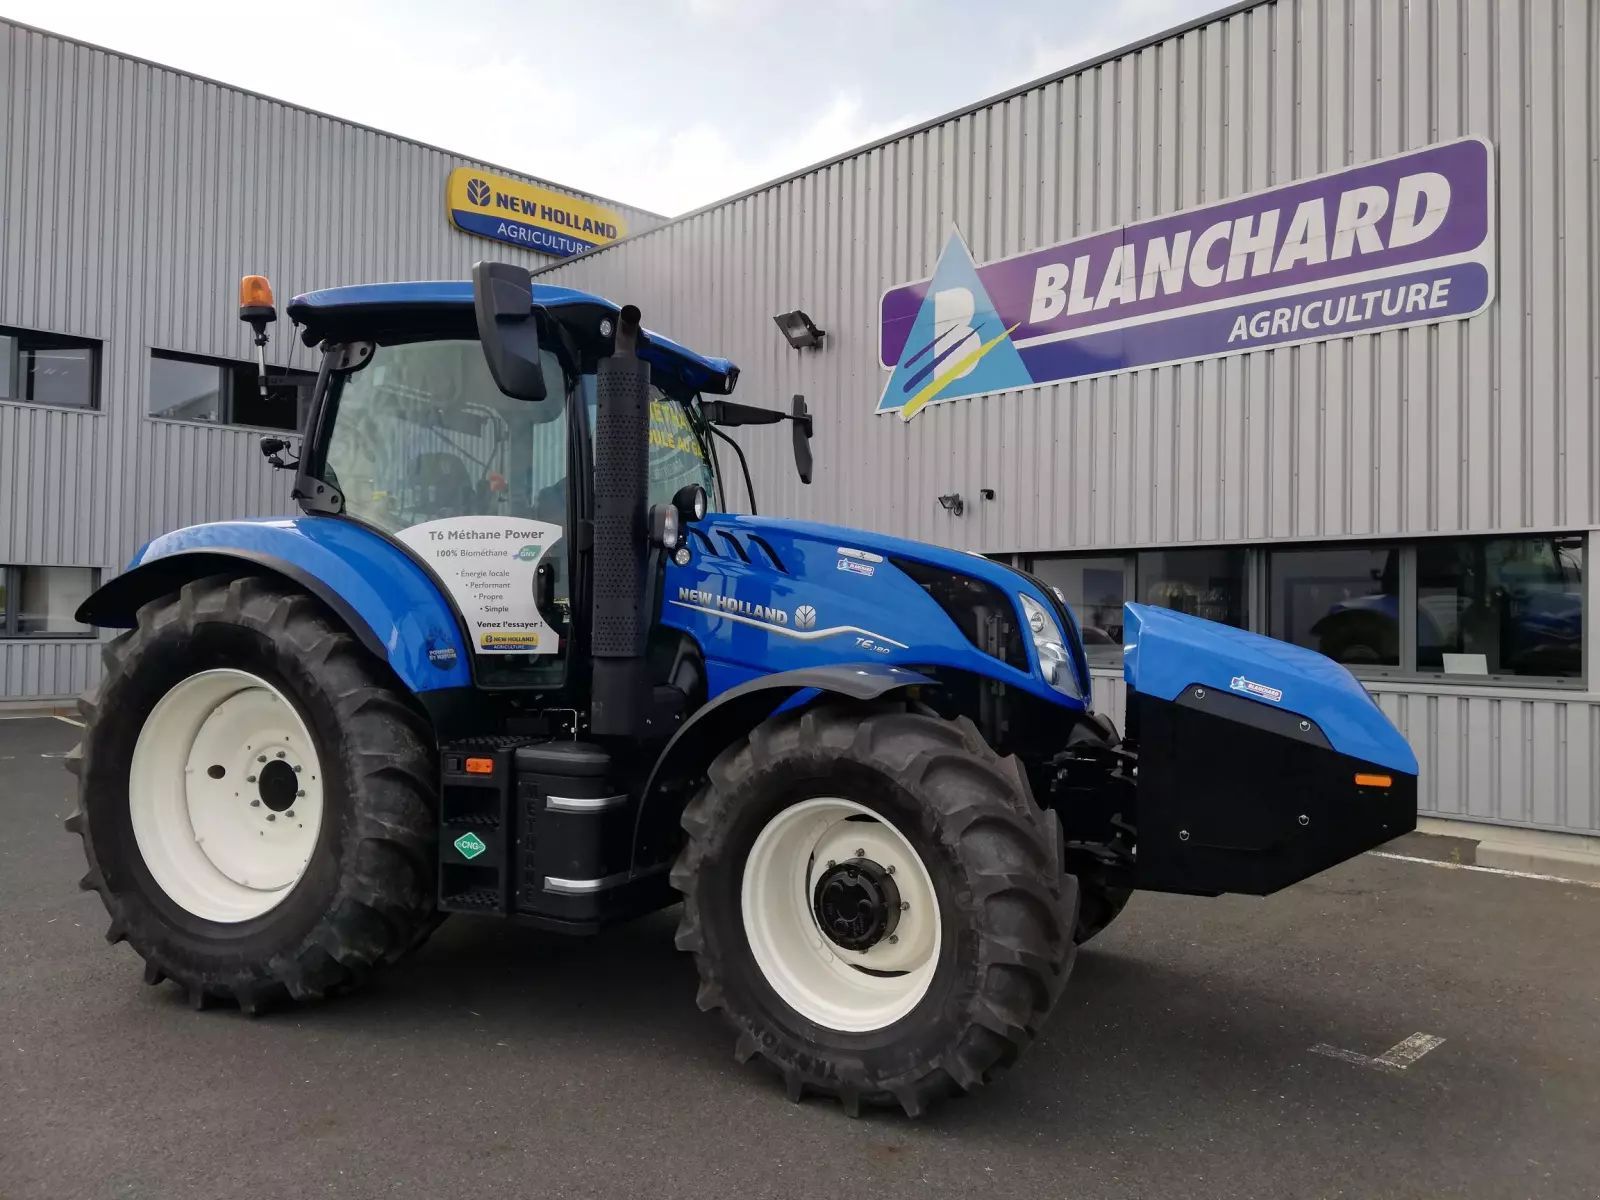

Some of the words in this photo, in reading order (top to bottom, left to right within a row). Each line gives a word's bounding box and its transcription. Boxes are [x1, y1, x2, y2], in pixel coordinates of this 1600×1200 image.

[496, 191, 536, 217] NEW
[541, 205, 617, 240] HOLLAND
[1029, 172, 1451, 325] BLANCHARD
[1227, 278, 1452, 344] AGRICULTURE
[429, 531, 444, 541] T6
[448, 530, 501, 540] Méthane
[505, 529, 544, 539] Power
[460, 549, 508, 557] Biométhane
[460, 569, 487, 578] Énergie
[478, 592, 503, 602] Propre
[484, 605, 509, 614] Simple
[679, 587, 712, 605] NEW
[716, 595, 788, 625] HOLLAND
[503, 621, 538, 629] l'essayer
[461, 841, 479, 850] CNG
